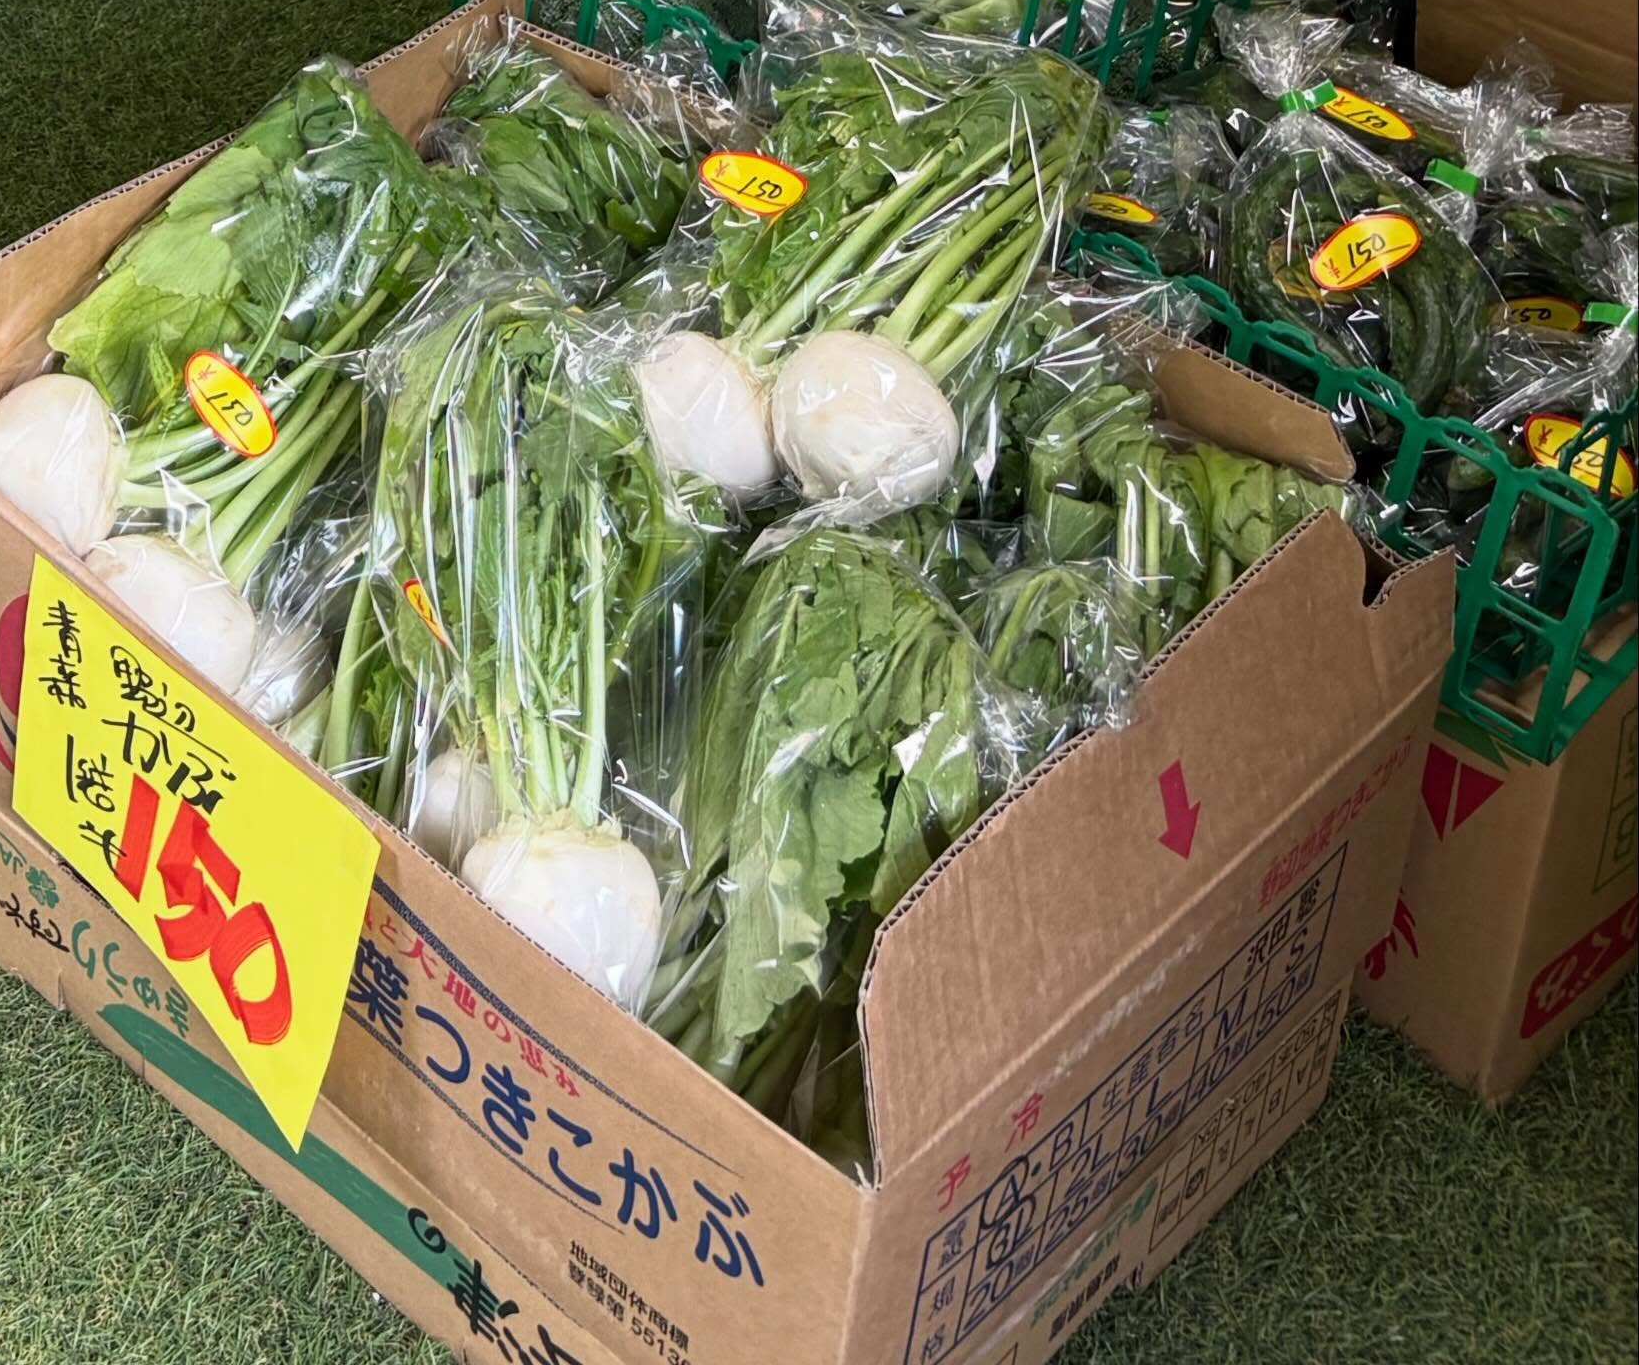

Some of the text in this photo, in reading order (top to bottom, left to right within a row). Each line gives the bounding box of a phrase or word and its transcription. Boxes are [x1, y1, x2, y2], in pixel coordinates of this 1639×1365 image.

[102, 711, 238, 816] かぶ
[365, 909, 582, 1101] と大地の恵み
